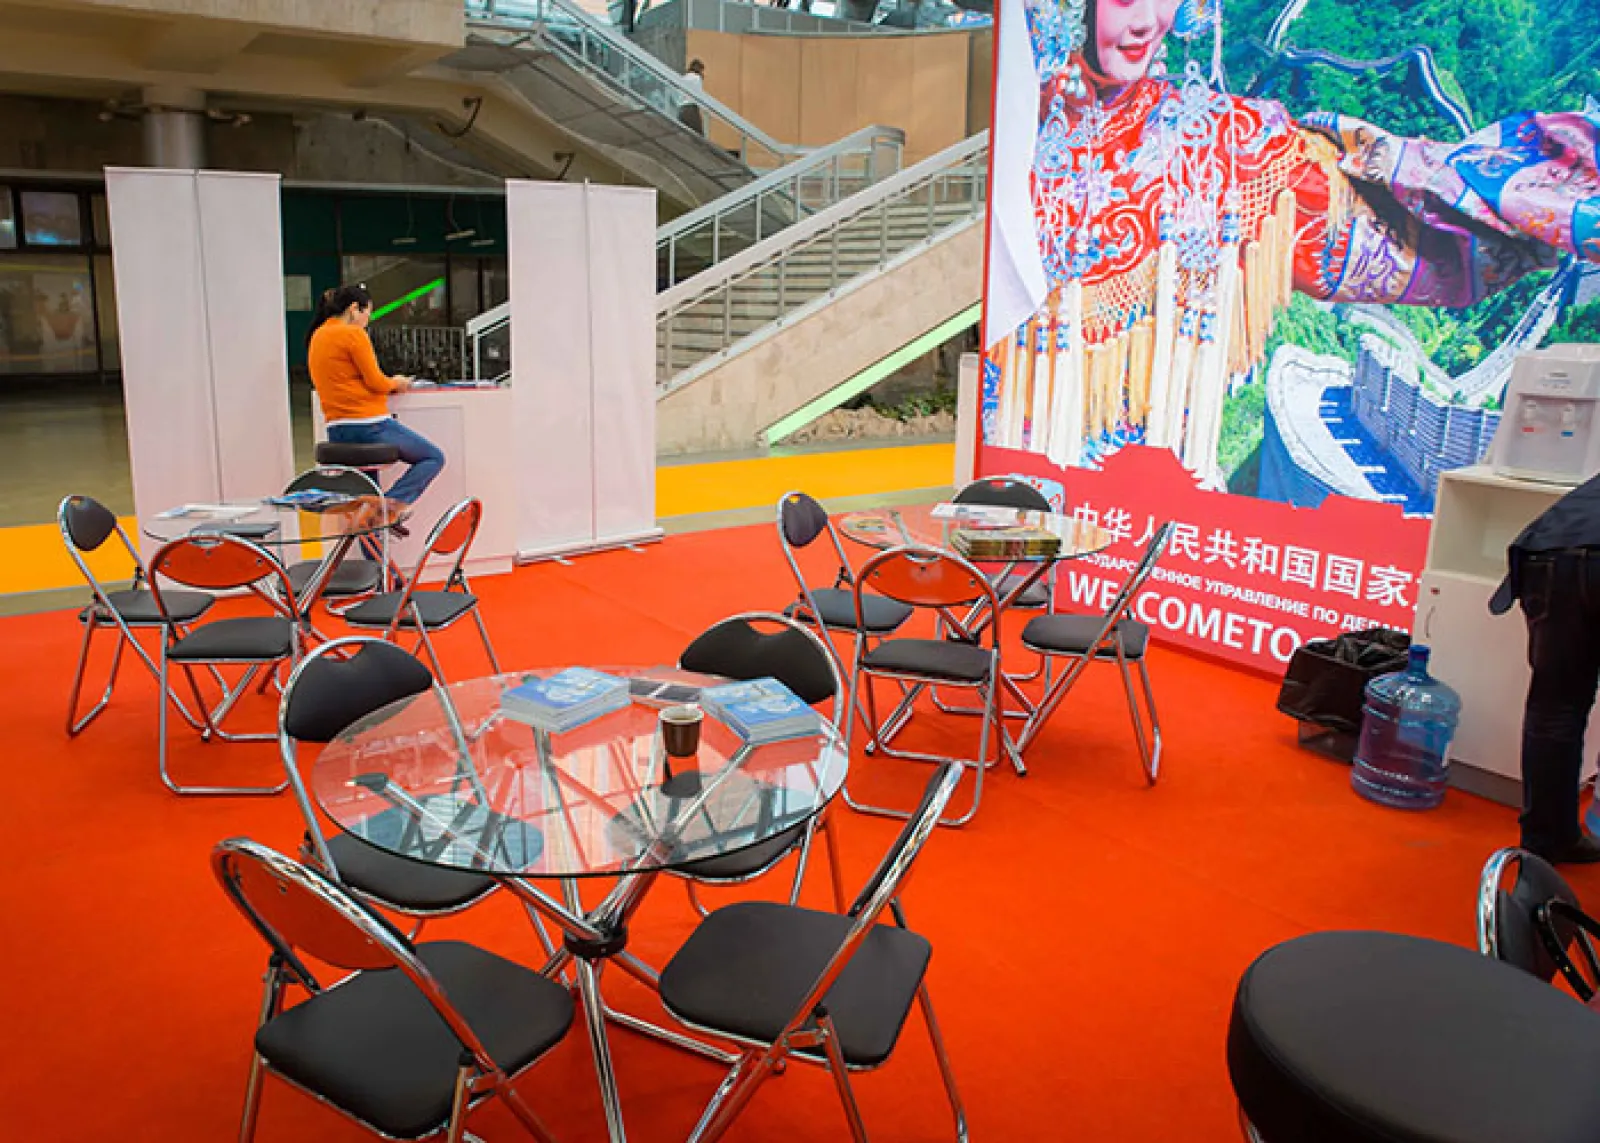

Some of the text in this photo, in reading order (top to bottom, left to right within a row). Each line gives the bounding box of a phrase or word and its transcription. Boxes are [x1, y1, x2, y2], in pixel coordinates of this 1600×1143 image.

[1072, 501, 1422, 612] 中华人民共和国国家
[1204, 578, 1310, 618] УПРАВЛЕНИЕ
[1313, 604, 1339, 625] ПО
[1069, 570, 1329, 663] WECOMETO
